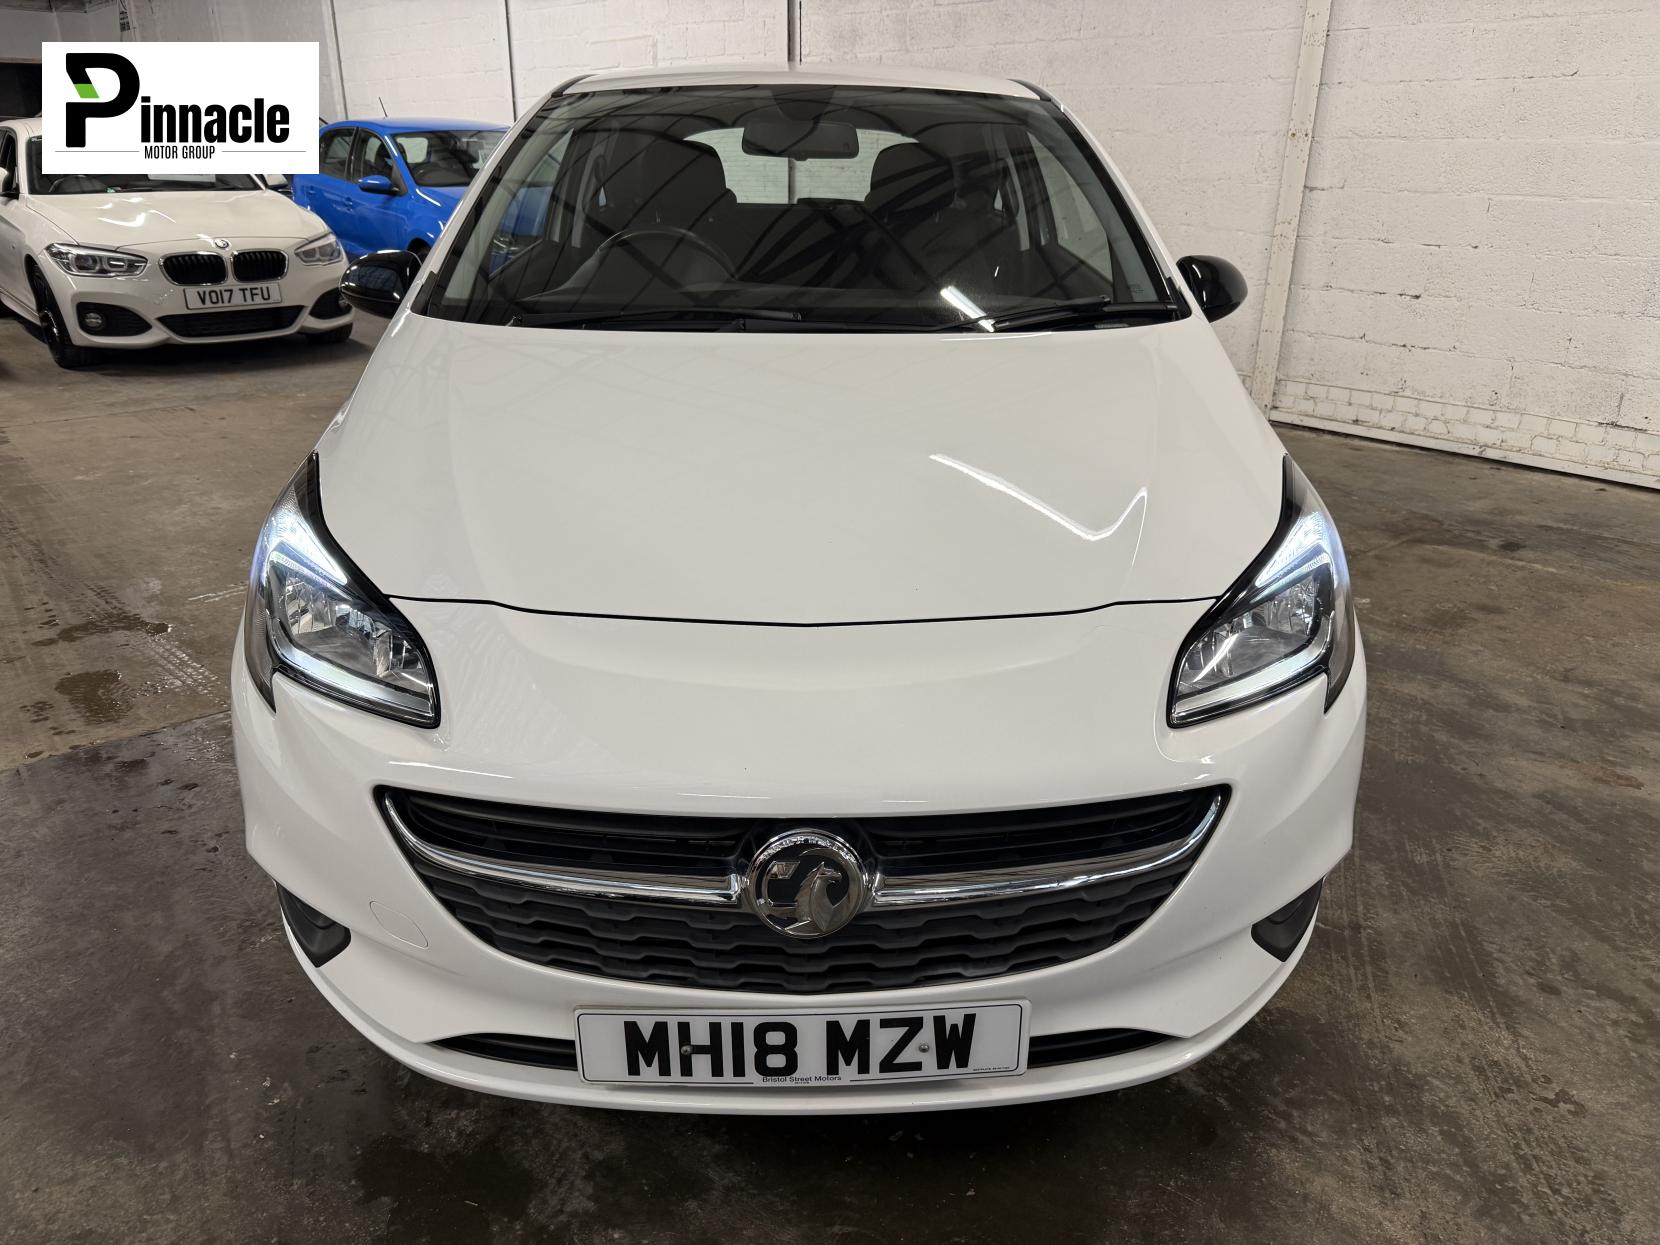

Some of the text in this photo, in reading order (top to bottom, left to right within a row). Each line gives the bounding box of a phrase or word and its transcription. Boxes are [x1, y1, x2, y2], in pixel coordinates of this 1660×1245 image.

[197, 286, 271, 306] VO17 TFU
[623, 1012, 977, 1078] MH18 MZW
[762, 1075, 787, 1083] Bristol
